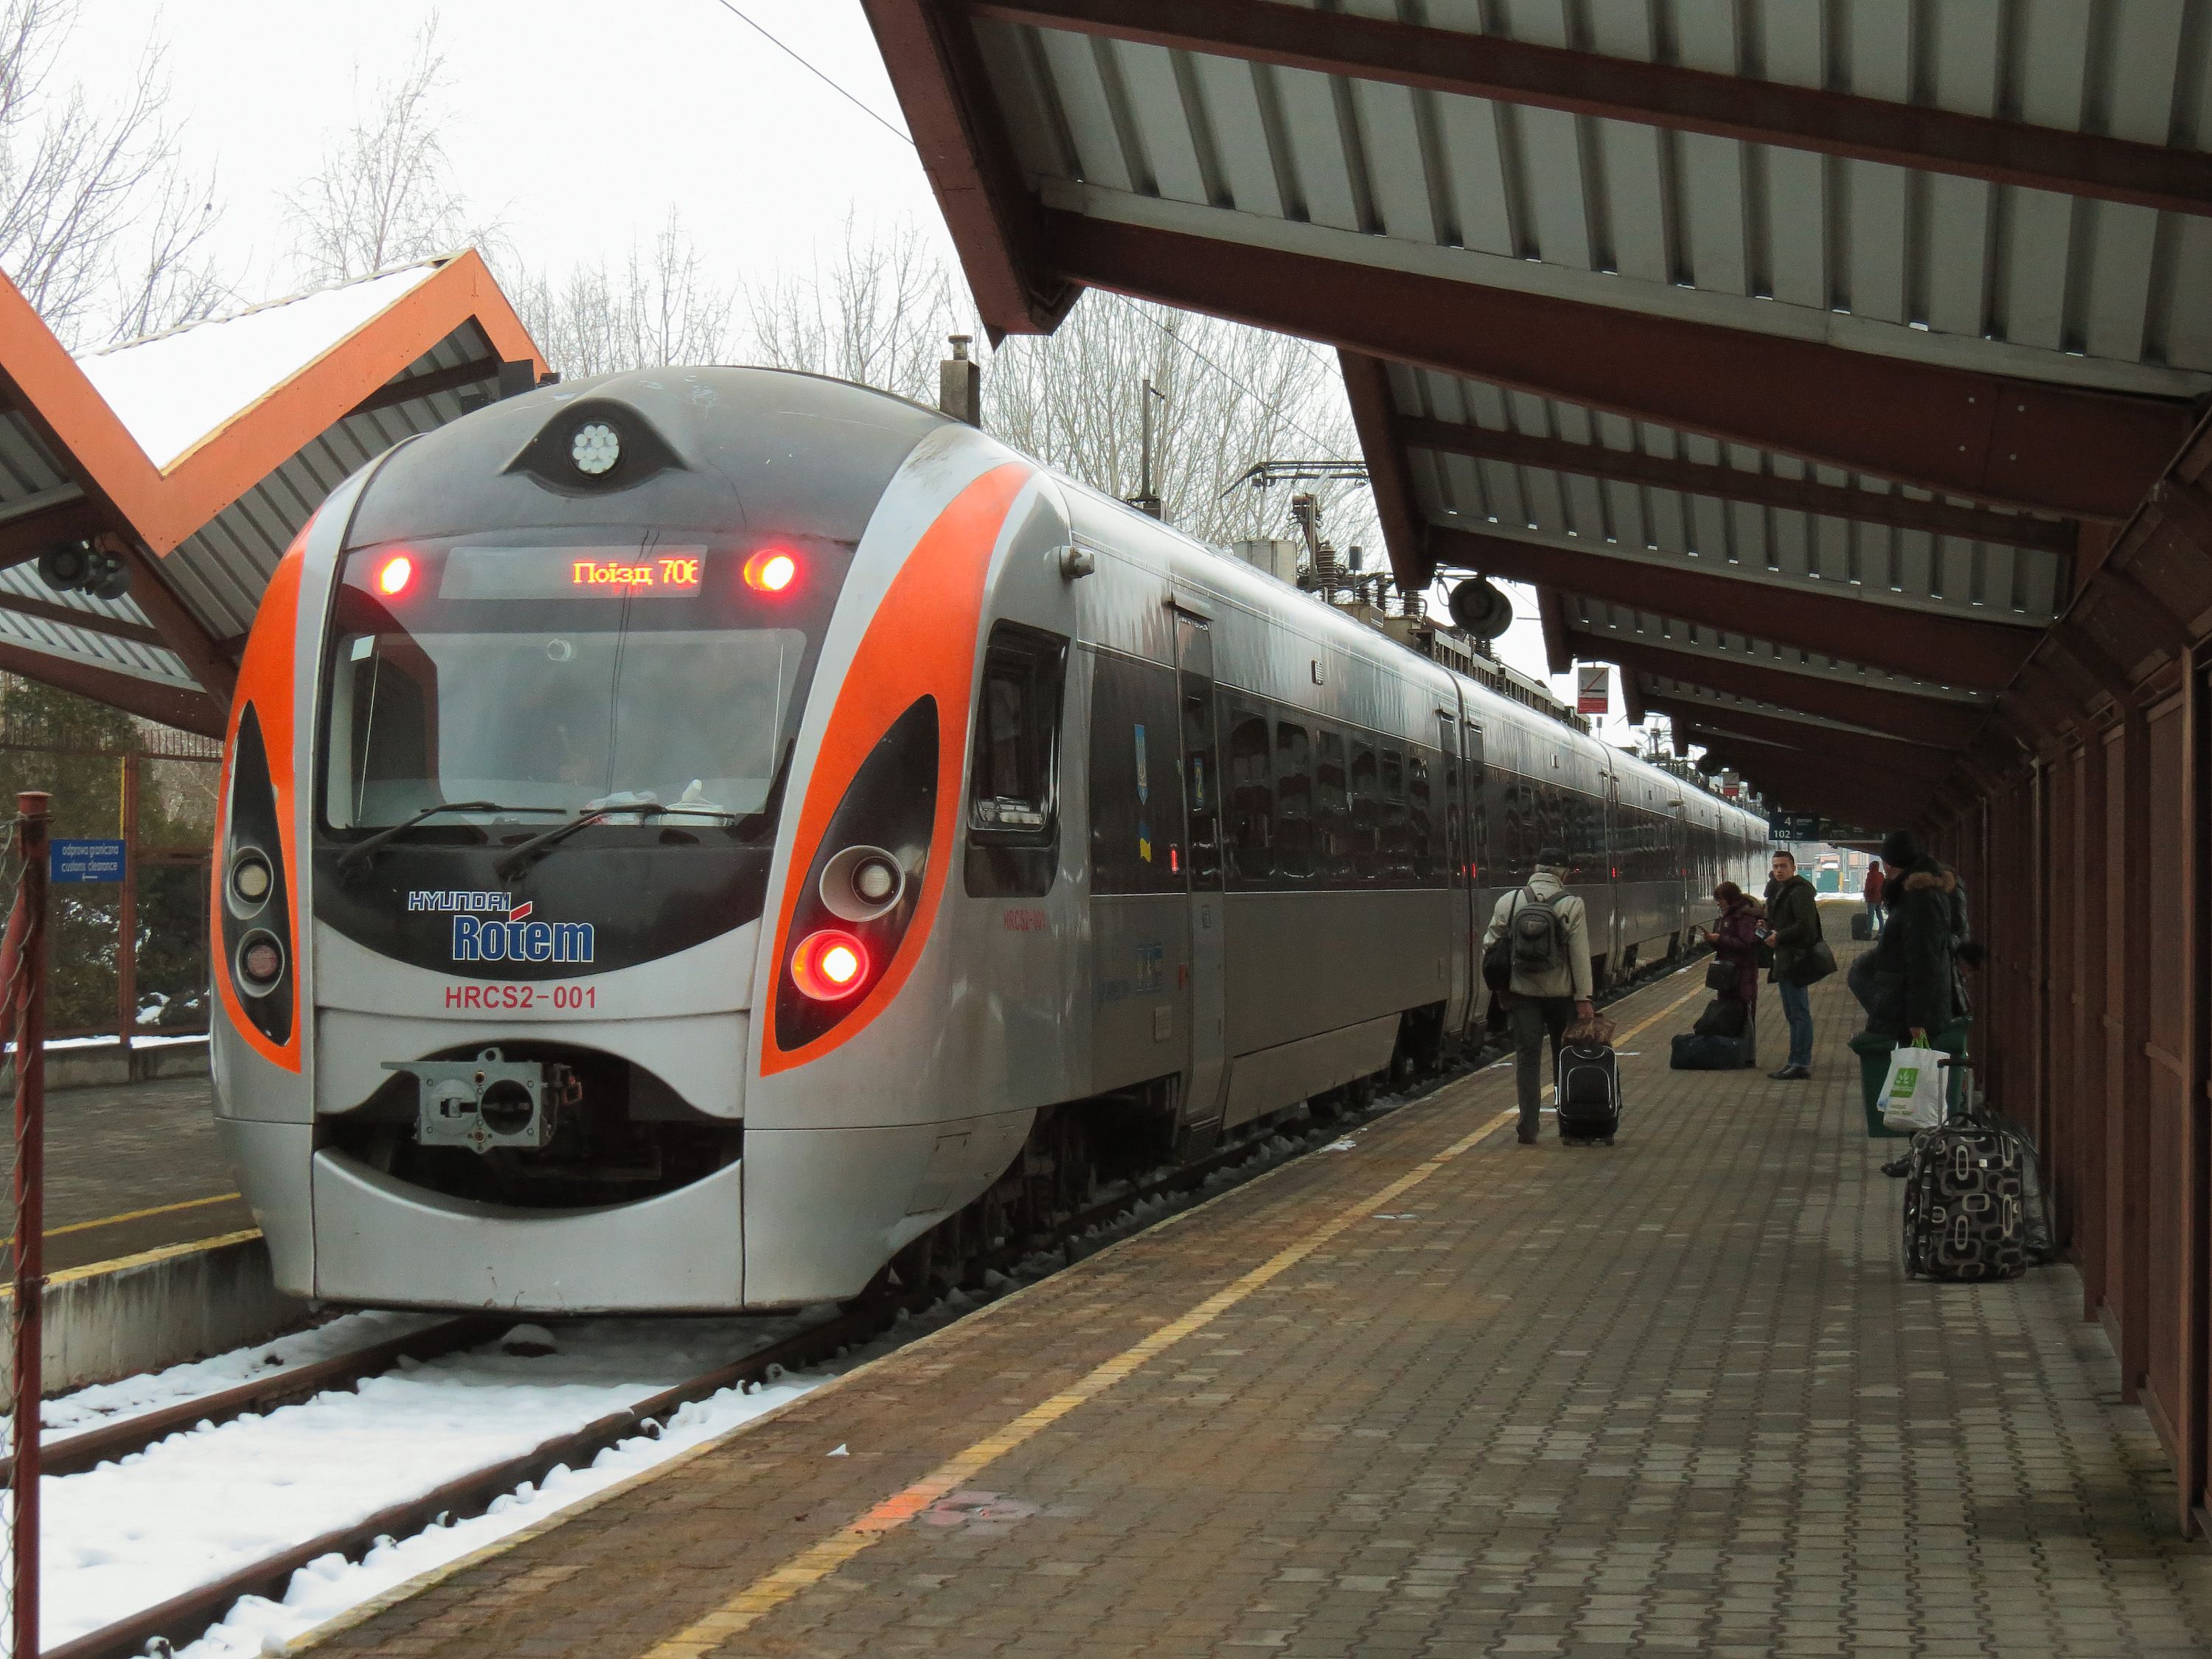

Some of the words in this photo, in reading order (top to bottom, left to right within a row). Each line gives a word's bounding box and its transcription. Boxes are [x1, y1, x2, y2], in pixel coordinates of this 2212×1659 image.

[573, 562, 653, 585] Поїзд
[1784, 816, 1792, 826] 4
[1773, 830, 1791, 838] 102
[408, 891, 511, 911] HYUNDAI
[453, 914, 594, 962] Rotem
[445, 985, 597, 1009] HRCS2-001
